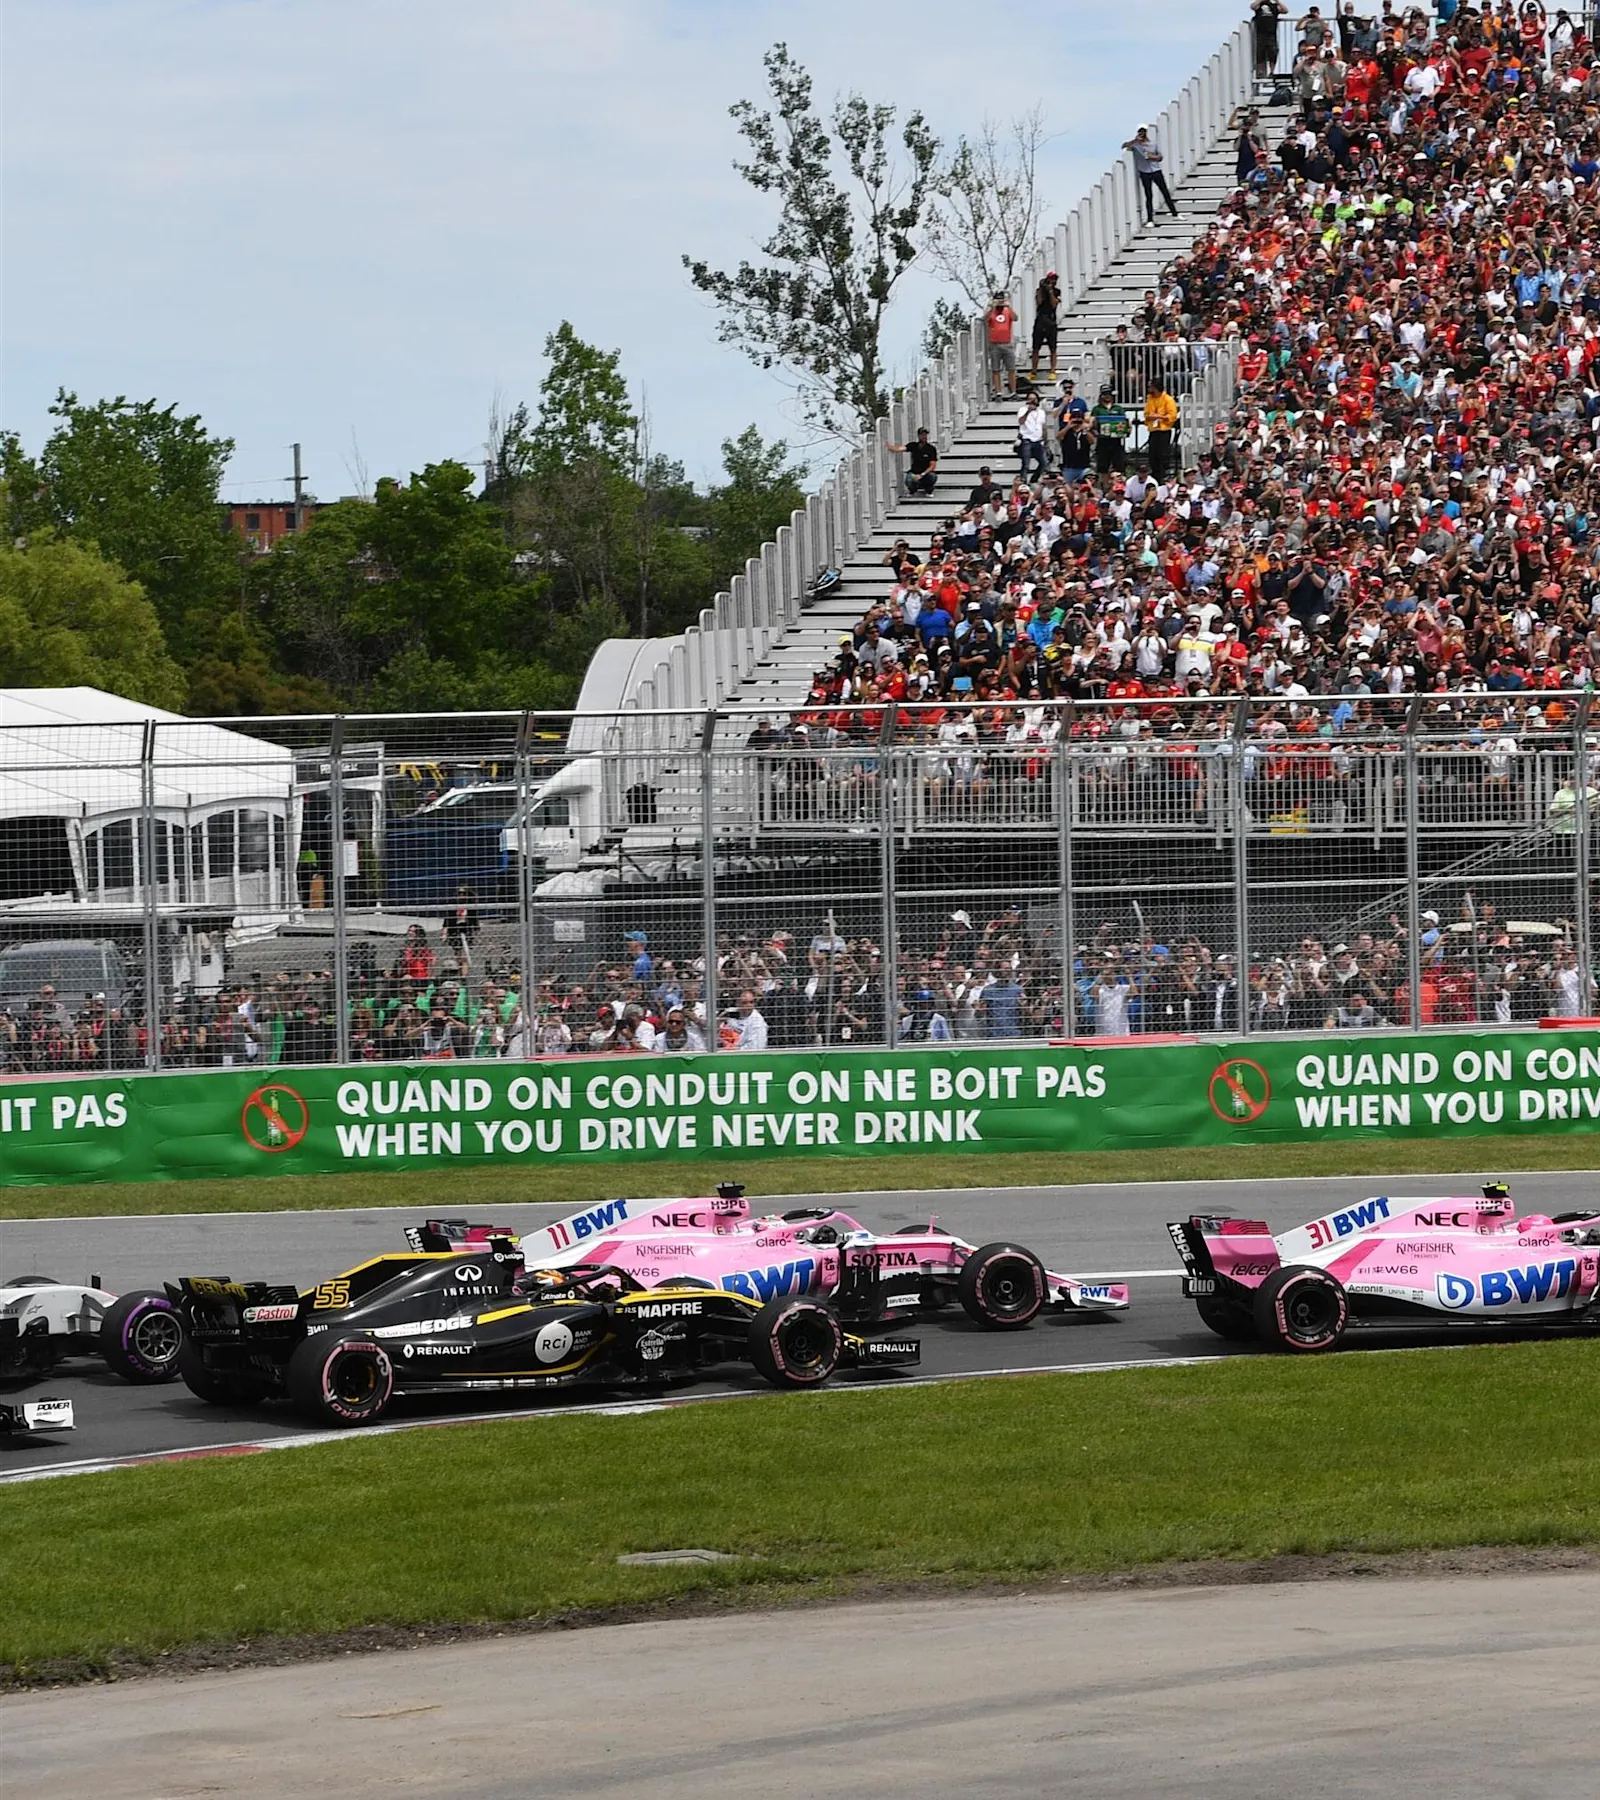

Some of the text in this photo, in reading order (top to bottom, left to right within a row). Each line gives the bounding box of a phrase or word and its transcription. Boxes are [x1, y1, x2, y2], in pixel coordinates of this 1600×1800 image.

[1297, 1053, 1438, 1089] QUAND
[1453, 1050, 1511, 1082] ON
[337, 1065, 1105, 1117] QUAND ON CONDUIT ON NE BOIT PAS
[53, 1093, 127, 1129] PAS
[1295, 1094, 1410, 1127] WHEN
[1423, 1091, 1503, 1123] YOU
[336, 1110, 982, 1156] WHEN YOU DRIVE NEVER DRINK
[711, 1200, 747, 1210] HYPE
[572, 1199, 629, 1239] BWT
[652, 1212, 706, 1228] NEC
[1332, 1197, 1391, 1238] BWT
[1415, 1212, 1470, 1228] NEC
[547, 1223, 570, 1250] 11
[756, 1237, 787, 1247] Claro
[1168, 1223, 1196, 1262] HYPE
[1306, 1220, 1333, 1249] 31
[1518, 1237, 1551, 1248] Claro
[636, 1244, 695, 1257] KINGFISHER
[1396, 1242, 1456, 1256] KINGFISHER
[852, 1252, 917, 1267] SOFINA
[1230, 1262, 1275, 1276] telcel
[721, 1257, 815, 1302] BWT
[1480, 1259, 1576, 1306] BWT
[314, 1280, 351, 1309] 55
[443, 1285, 499, 1297] INFINITI
[1080, 1286, 1110, 1298] BWT
[1348, 1284, 1384, 1293] Acronis
[256, 1306, 296, 1322] Castrol
[638, 1301, 703, 1319] MAPFRE
[420, 1315, 473, 1335] EDGE
[416, 1345, 473, 1356] RENAULT
[869, 1343, 918, 1353] RENAULT
[36, 1402, 70, 1412] POWER
